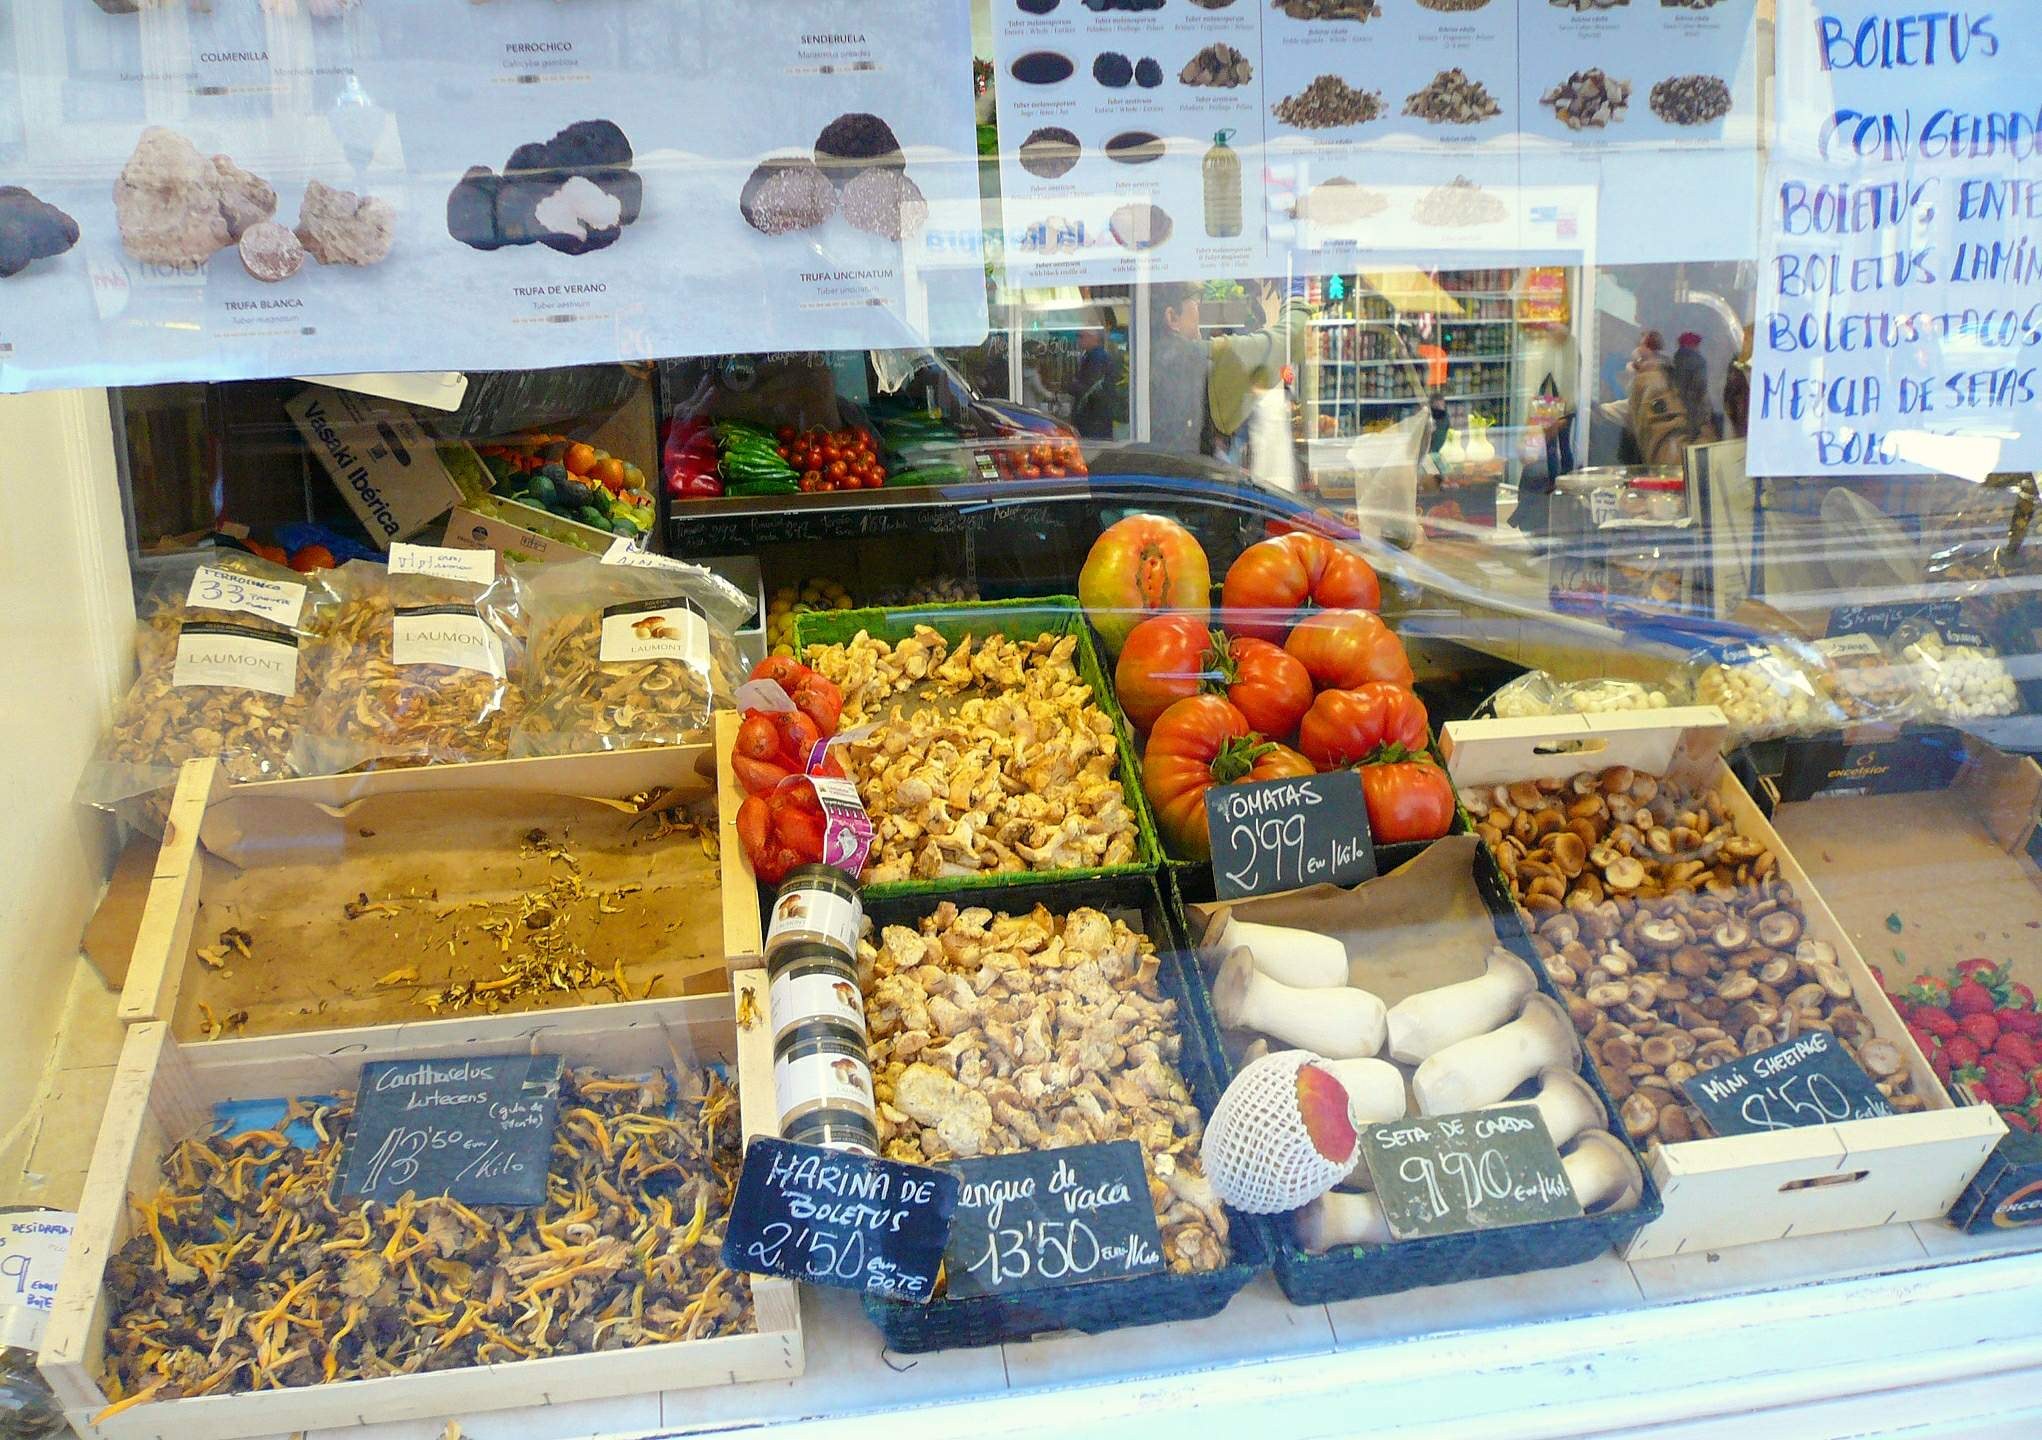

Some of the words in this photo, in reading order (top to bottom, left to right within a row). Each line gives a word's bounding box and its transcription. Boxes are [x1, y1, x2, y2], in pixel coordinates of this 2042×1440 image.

[506, 41, 572, 53] PERROCHICO
[801, 34, 866, 44] SENDERUELA
[1815, 12, 1998, 71] BOLETUS
[200, 51, 269, 63] COLMENILLA
[1780, 176, 1941, 236] BOLETUS
[799, 271, 831, 282] TRUFA
[834, 269, 893, 280] UNCINATUM
[1773, 245, 1936, 297] BOLETUS
[513, 287, 545, 297] TRUFA
[547, 286, 561, 295] DE
[563, 283, 607, 294] VERANO
[224, 301, 257, 311] TRUFA
[260, 299, 304, 310] BLANCA
[1898, 376, 1937, 415] DE
[1944, 368, 2038, 410] SETAS
[304, 400, 358, 469] Vasaki
[347, 466, 400, 537] Ibérica
[631, 643, 681, 653] LAUMONT
[189, 654, 282, 672] LAUMONT
[1827, 765, 1889, 779] excelsior
[1224, 781, 1322, 823] TOMATAS
[1376, 1127, 1431, 1149] SETA
[1438, 1119, 1464, 1138] DE
[900, 1179, 936, 1204] DE
[958, 1178, 1036, 1230] engua
[781, 1190, 909, 1232] BOLETUS
